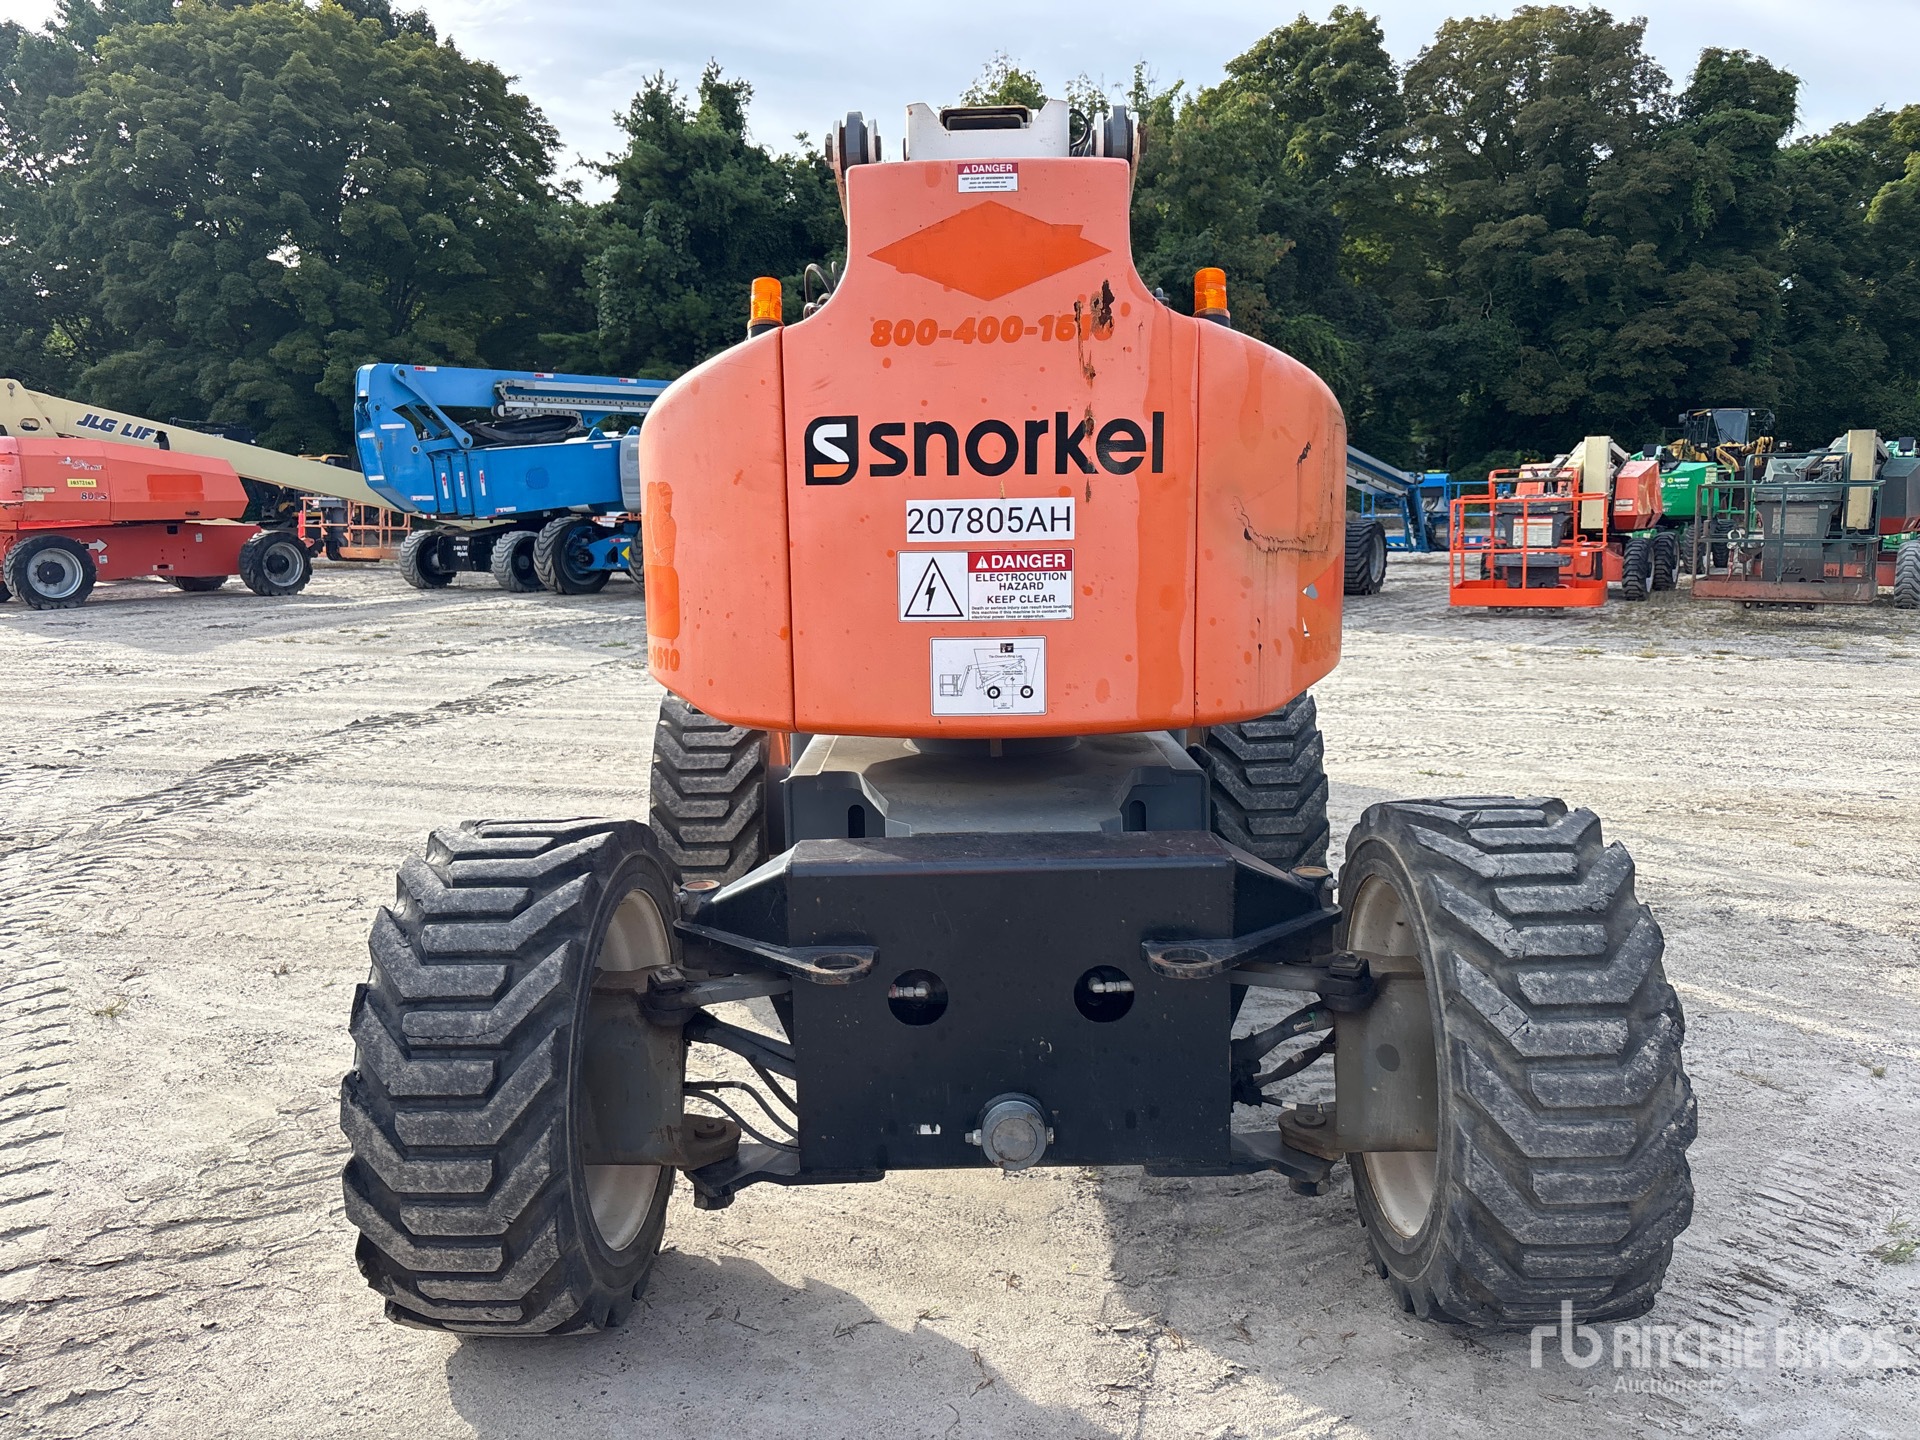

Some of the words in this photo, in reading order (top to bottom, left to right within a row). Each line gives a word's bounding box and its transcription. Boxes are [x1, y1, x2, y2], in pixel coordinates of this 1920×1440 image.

[971, 164, 1013, 173] DANGER
[76, 413, 118, 432] JLG
[869, 411, 1165, 477] snorkel
[907, 506, 1071, 535] 207805AH
[991, 554, 1066, 568] DANGER
[975, 572, 1067, 582] ELECTROCUTION
[998, 582, 1044, 590] HAZARD
[987, 595, 1016, 604] KEEP
[1019, 594, 1056, 603] CLEAR
